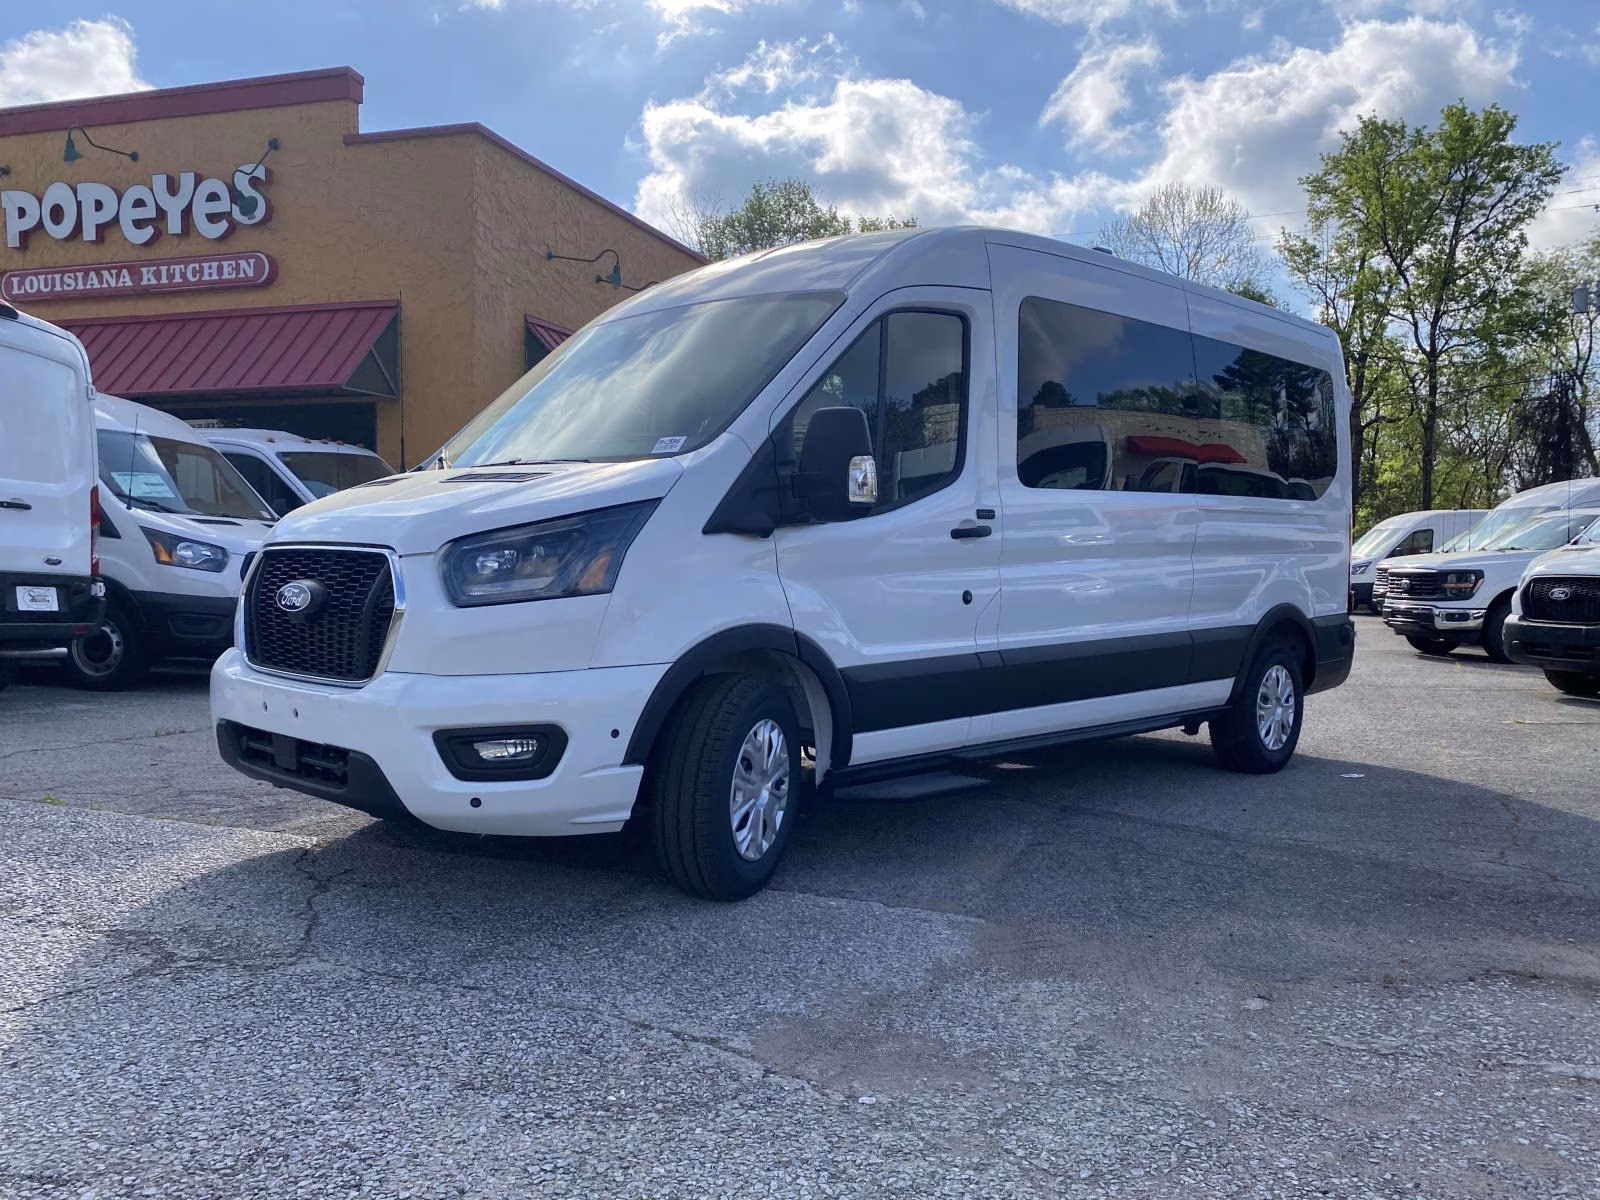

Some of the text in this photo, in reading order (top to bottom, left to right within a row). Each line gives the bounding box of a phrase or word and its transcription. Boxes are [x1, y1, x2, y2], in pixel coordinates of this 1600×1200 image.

[11, 258, 256, 295] LOUISIANA KITCHEN
[281, 587, 304, 607] Ford
